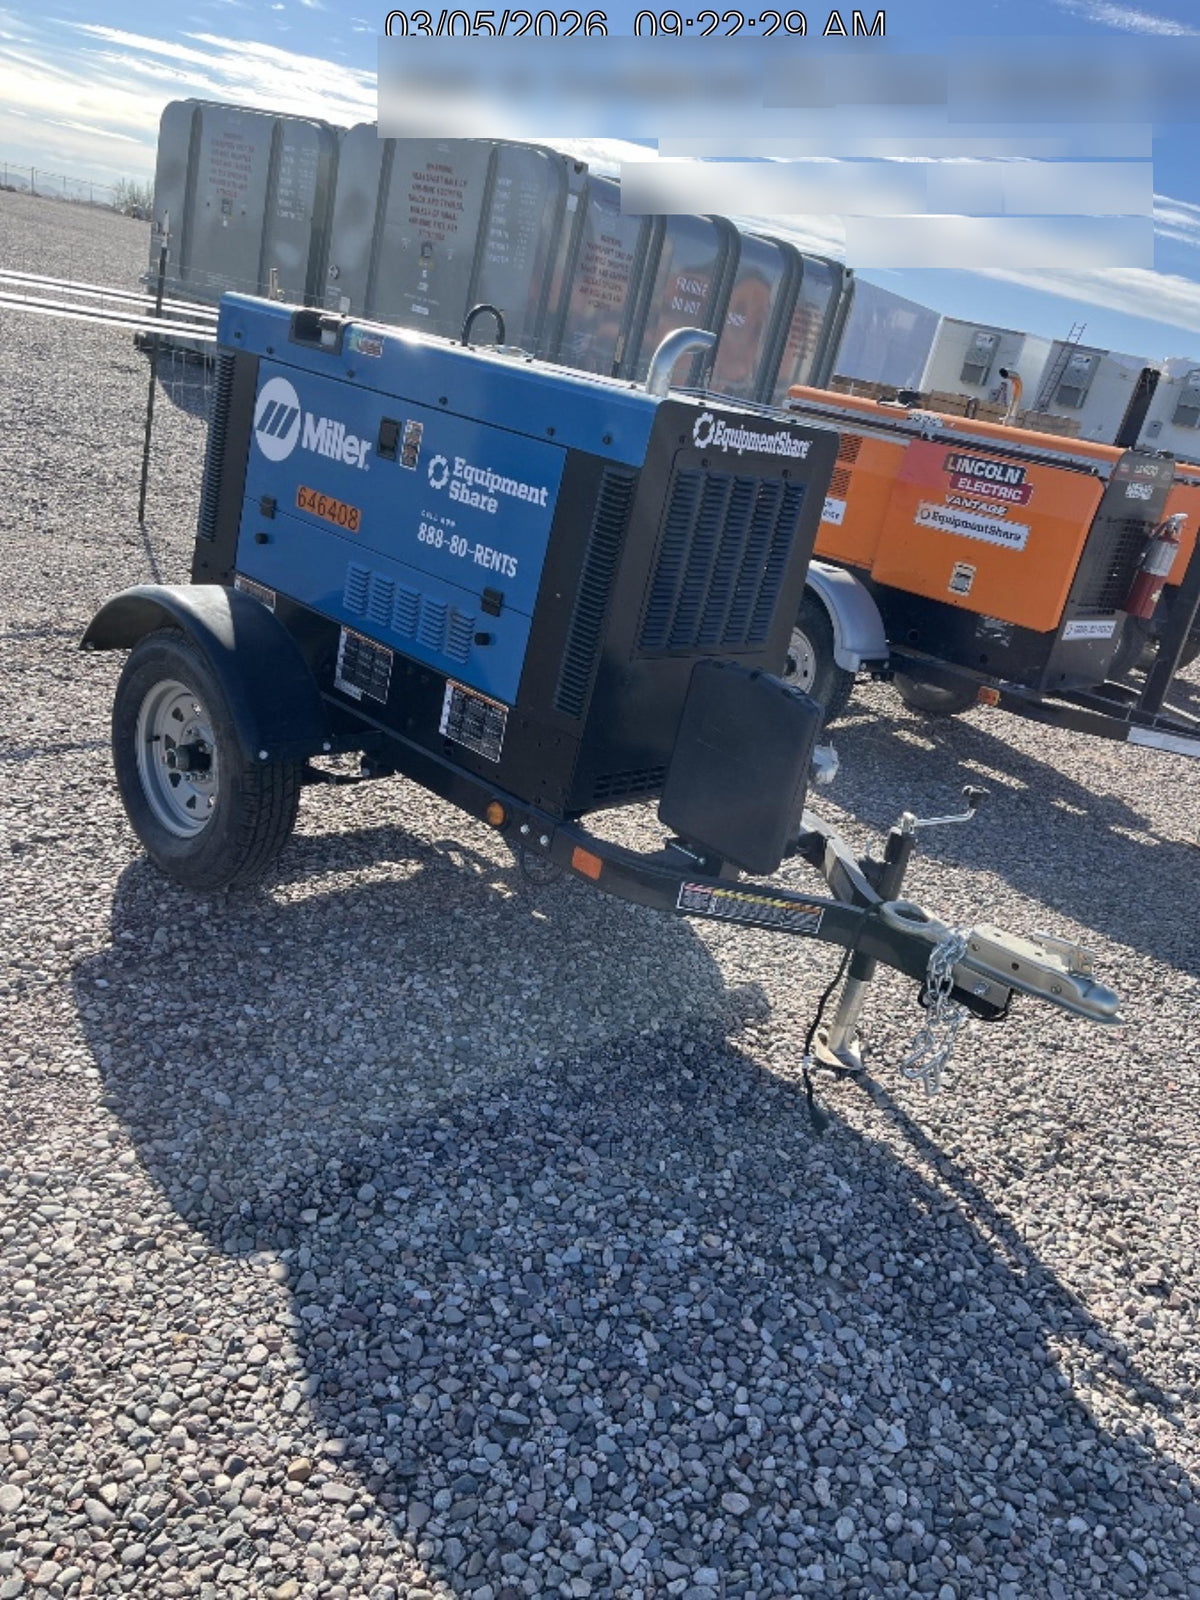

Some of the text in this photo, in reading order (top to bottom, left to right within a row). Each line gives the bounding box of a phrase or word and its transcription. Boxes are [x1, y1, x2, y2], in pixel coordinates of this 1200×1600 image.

[301, 412, 372, 470] Miller
[713, 418, 810, 459] EquipmentShare
[452, 457, 549, 507] Equipment
[947, 456, 1021, 484] LINCOLN
[957, 477, 1023, 500] ELECTRIC
[297, 486, 360, 531] 646408
[449, 481, 498, 514] Share
[931, 511, 1021, 541] EquipmentShare
[417, 522, 518, 578] 888-80-RENTS
